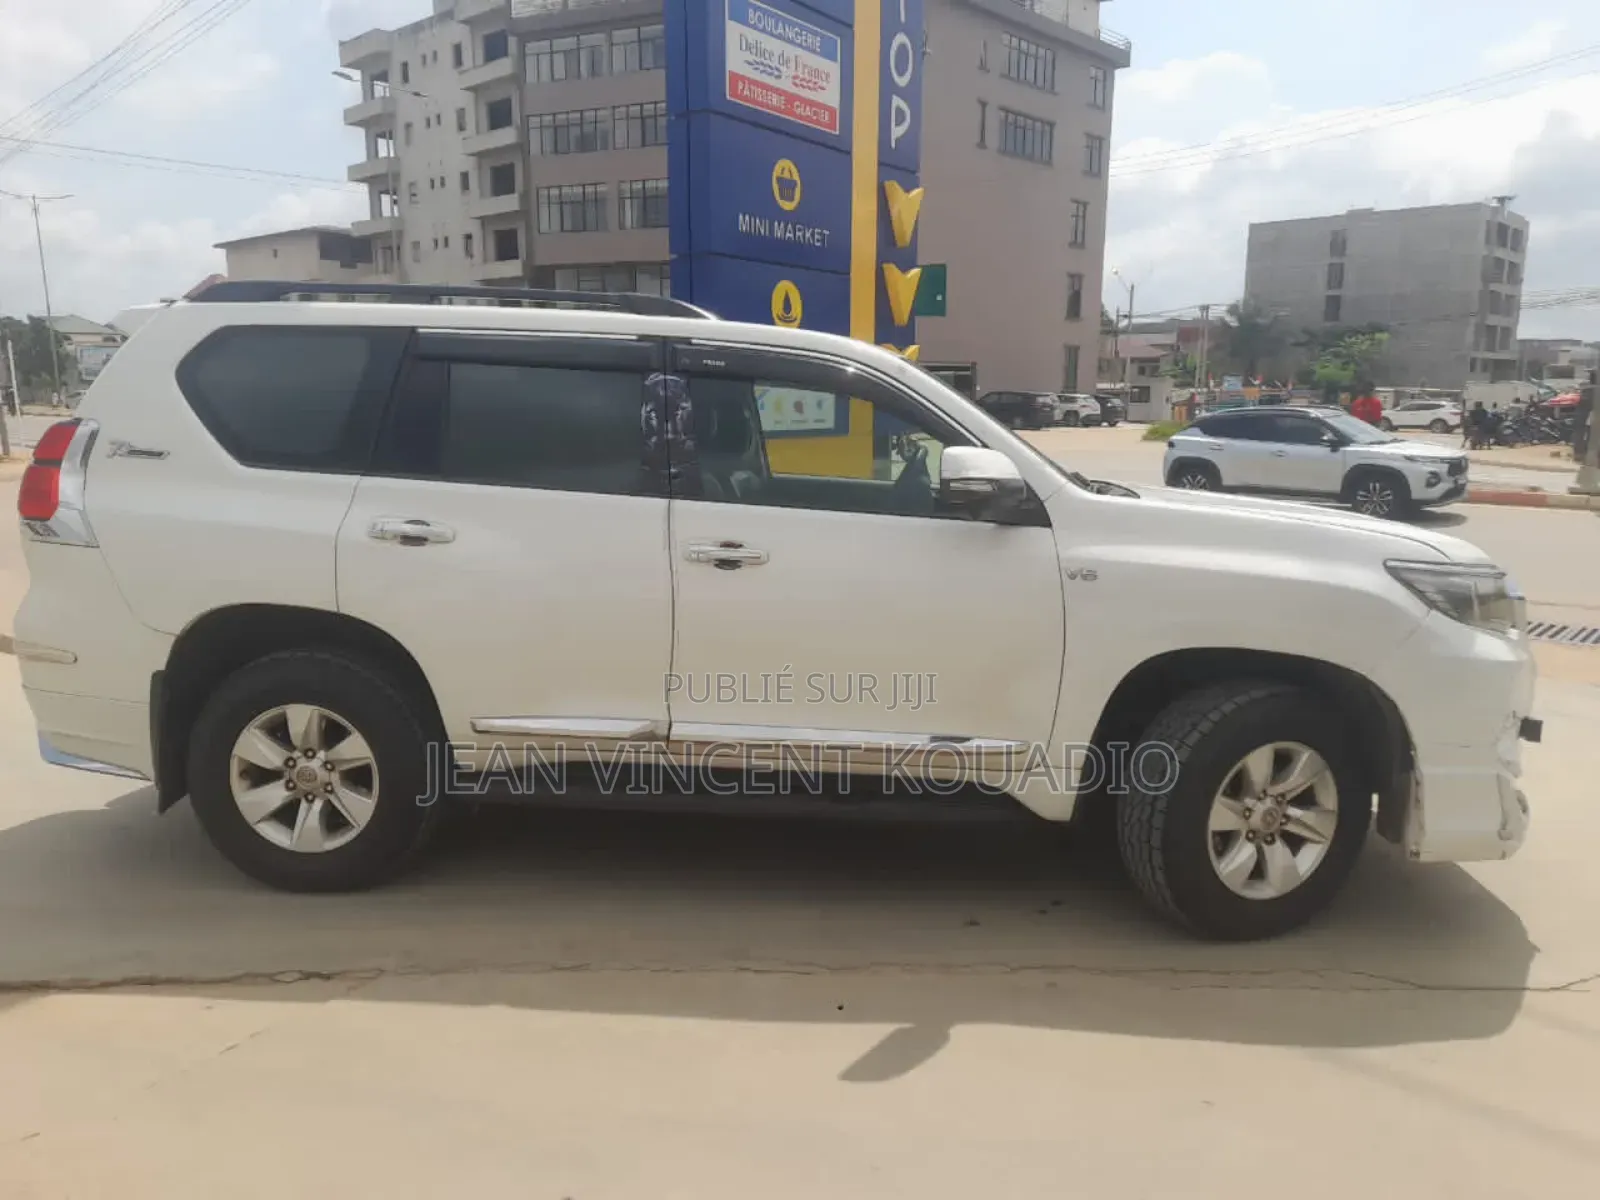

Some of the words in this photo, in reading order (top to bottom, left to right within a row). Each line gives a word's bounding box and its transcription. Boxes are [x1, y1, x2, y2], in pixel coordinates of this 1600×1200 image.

[748, 8, 821, 52] BOULANGERIE
[778, 49, 791, 68] de
[794, 55, 831, 83] France
[793, 101, 830, 122] GLACIER
[738, 212, 769, 237] MINI
[774, 219, 830, 248] MARKET
